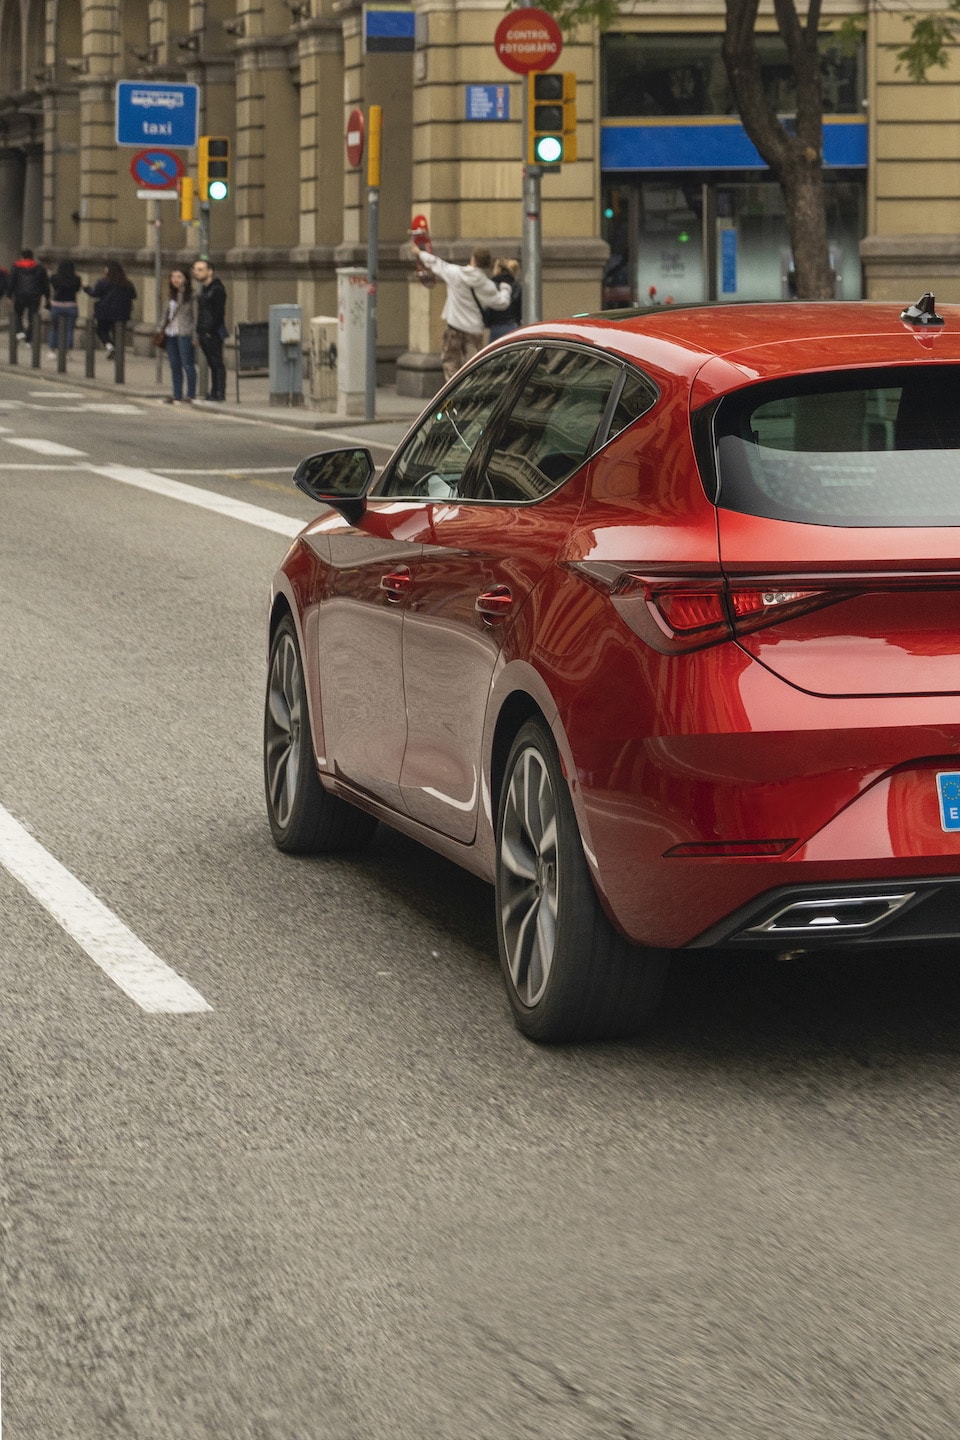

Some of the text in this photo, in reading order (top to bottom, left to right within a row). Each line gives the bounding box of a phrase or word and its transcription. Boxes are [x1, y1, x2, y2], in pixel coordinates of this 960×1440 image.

[506, 29, 551, 40] CONTROL
[142, 121, 173, 135] taxi
[949, 807, 960, 820] E
